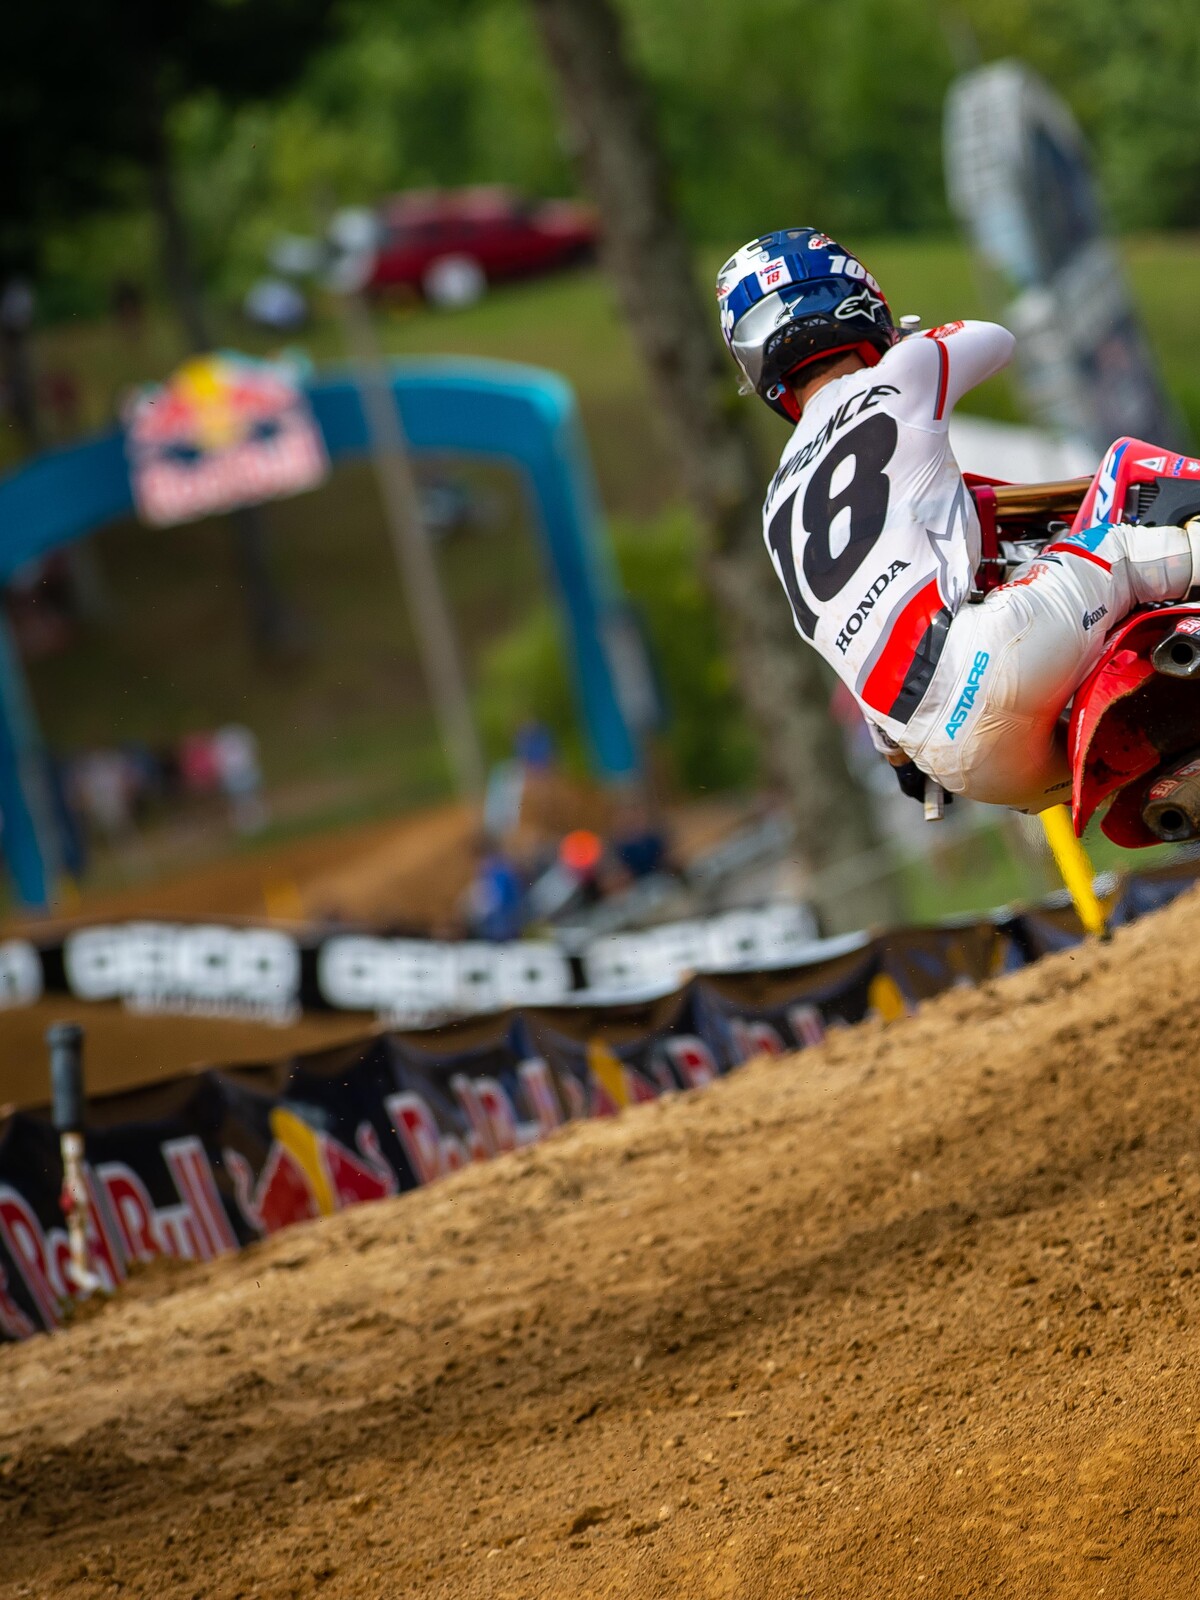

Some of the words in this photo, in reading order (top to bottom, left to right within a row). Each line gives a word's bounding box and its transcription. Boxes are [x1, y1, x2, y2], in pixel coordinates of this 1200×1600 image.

[766, 270, 781, 286] 18
[767, 411, 899, 641] 18
[834, 559, 912, 656] HONDA
[945, 650, 990, 741] ASTARS
